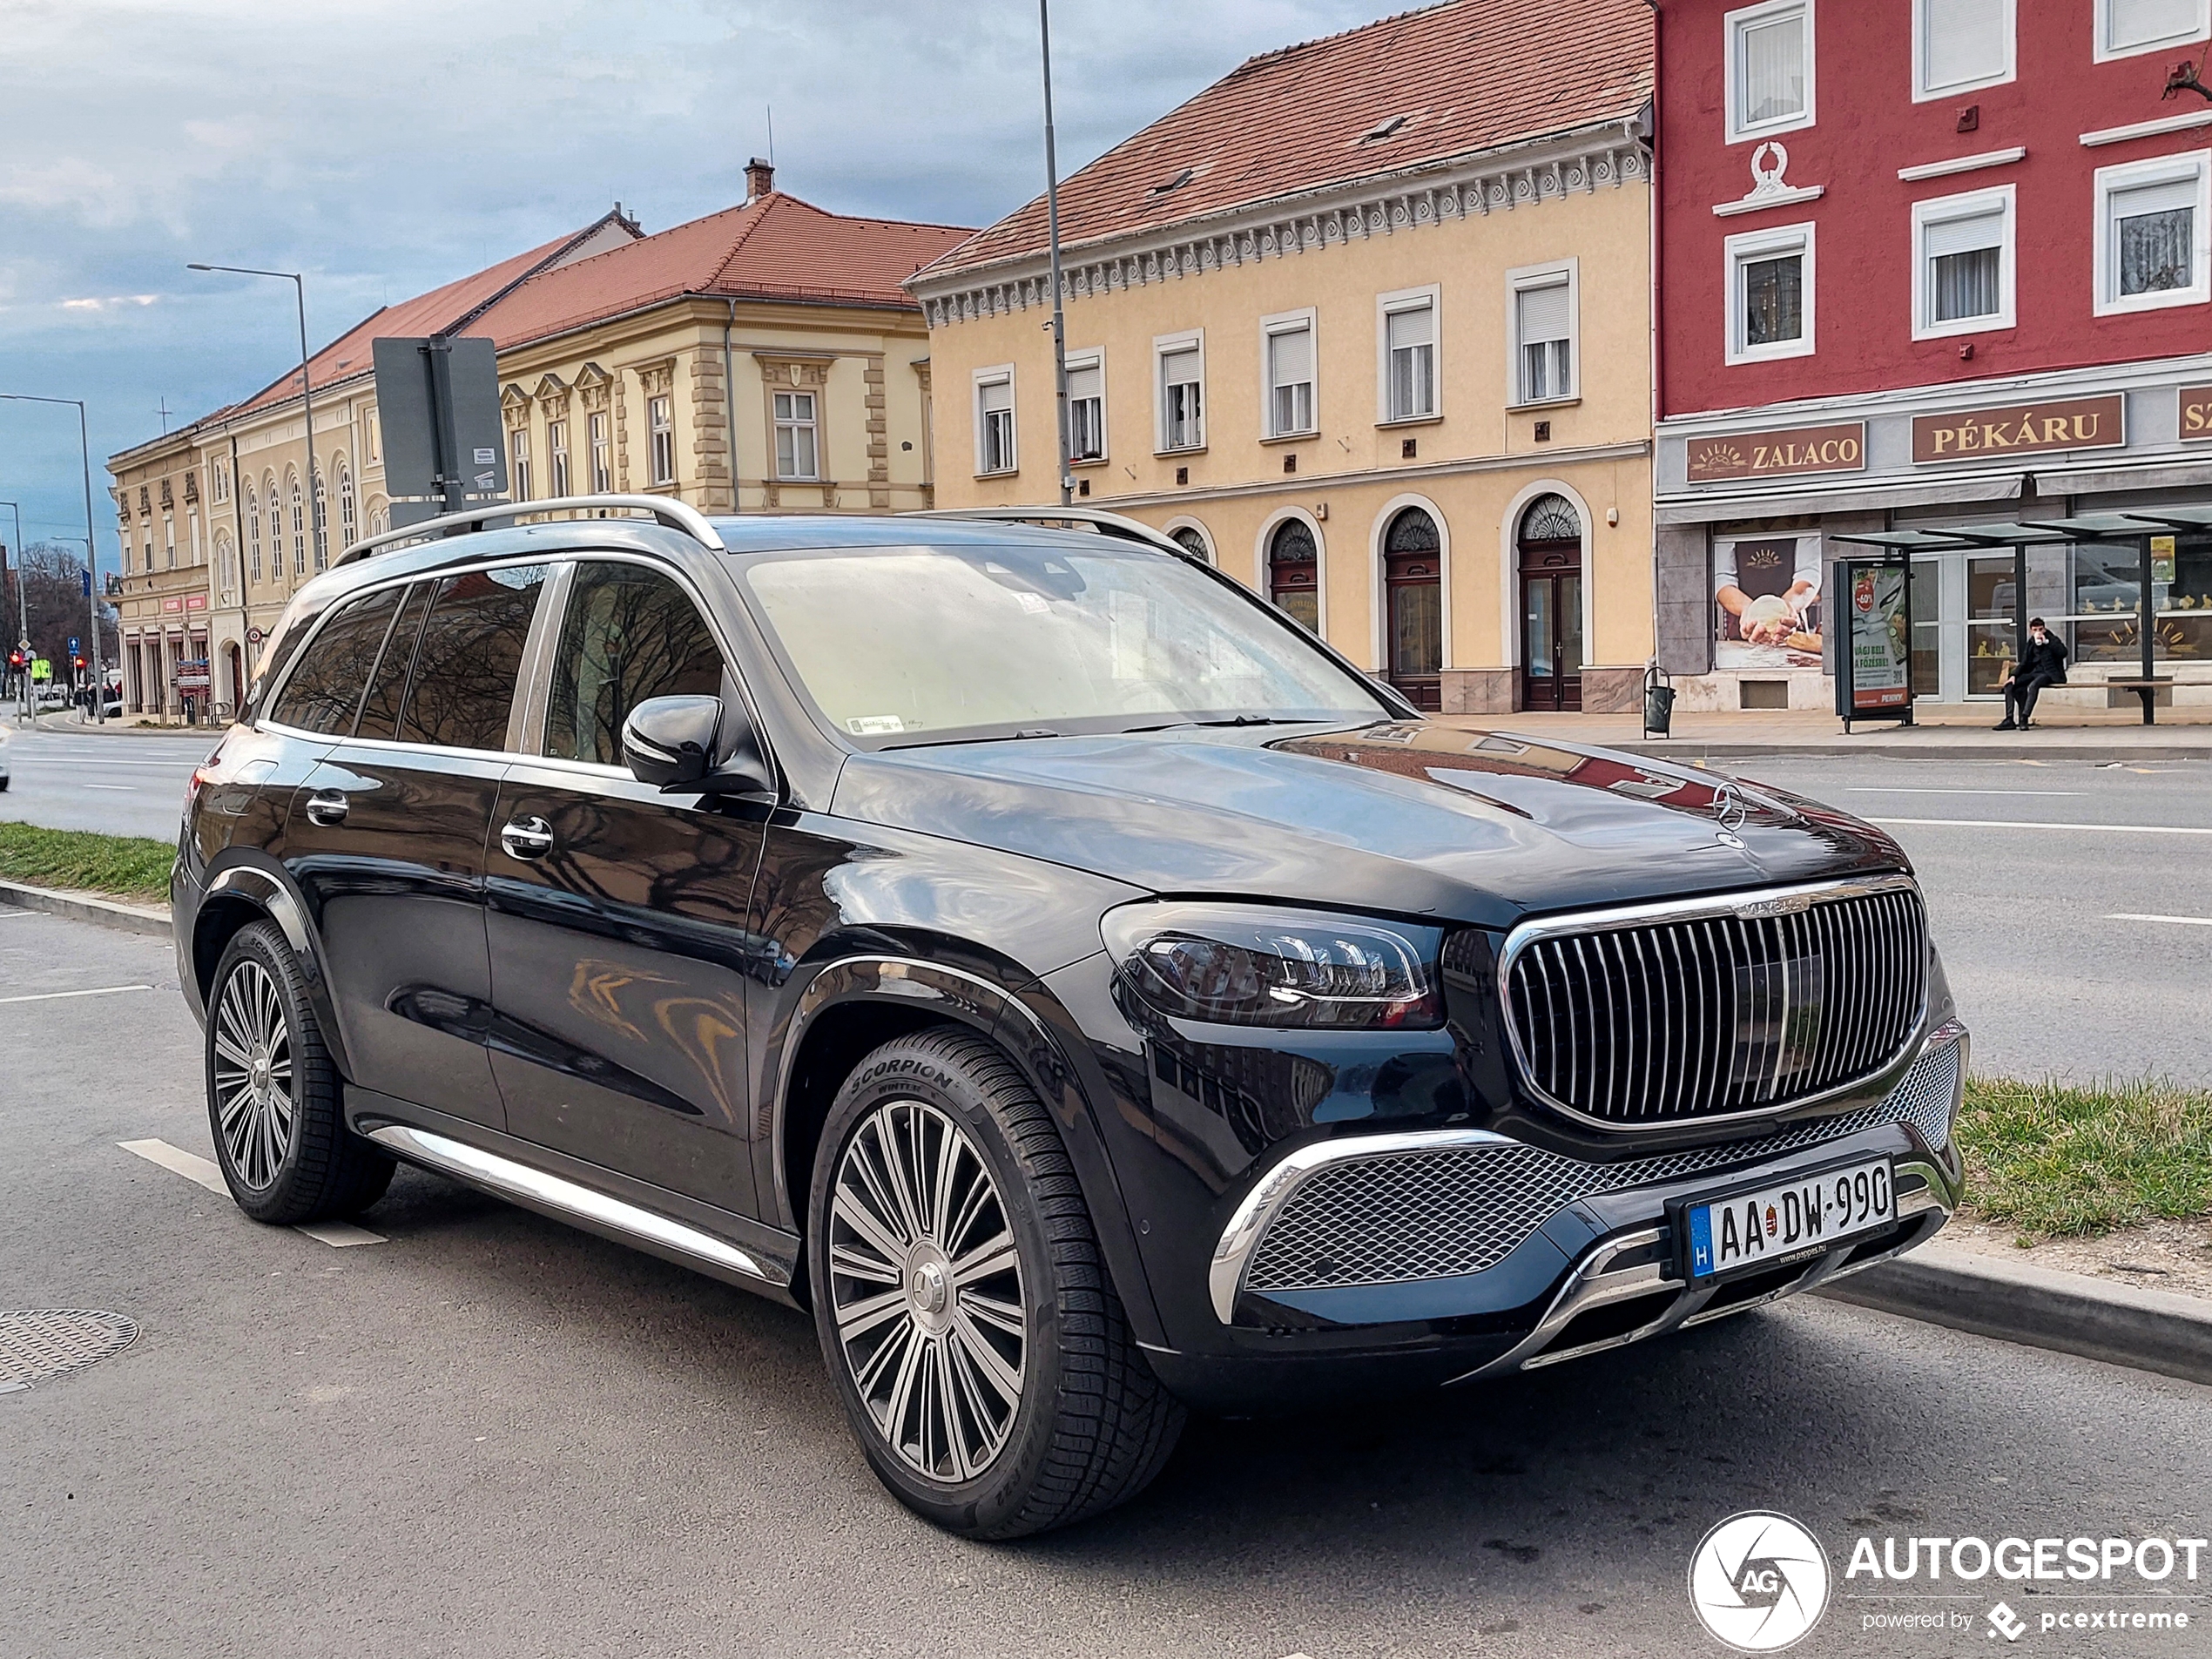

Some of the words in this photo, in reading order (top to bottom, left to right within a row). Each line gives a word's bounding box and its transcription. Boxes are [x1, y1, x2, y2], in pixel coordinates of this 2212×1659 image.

[1932, 412, 2101, 454] PÉKÁRU
[1699, 444, 1741, 462] ZALACO
[1752, 438, 1858, 469] ZALACO
[851, 1059, 953, 1095] SCORPION
[878, 1082, 921, 1095] WINTER
[1721, 1200, 1765, 1261] AA
[1781, 1165, 1888, 1244] DW-990
[1695, 1245, 1708, 1266] H
[1779, 1244, 1827, 1264] www.pappas.hu
